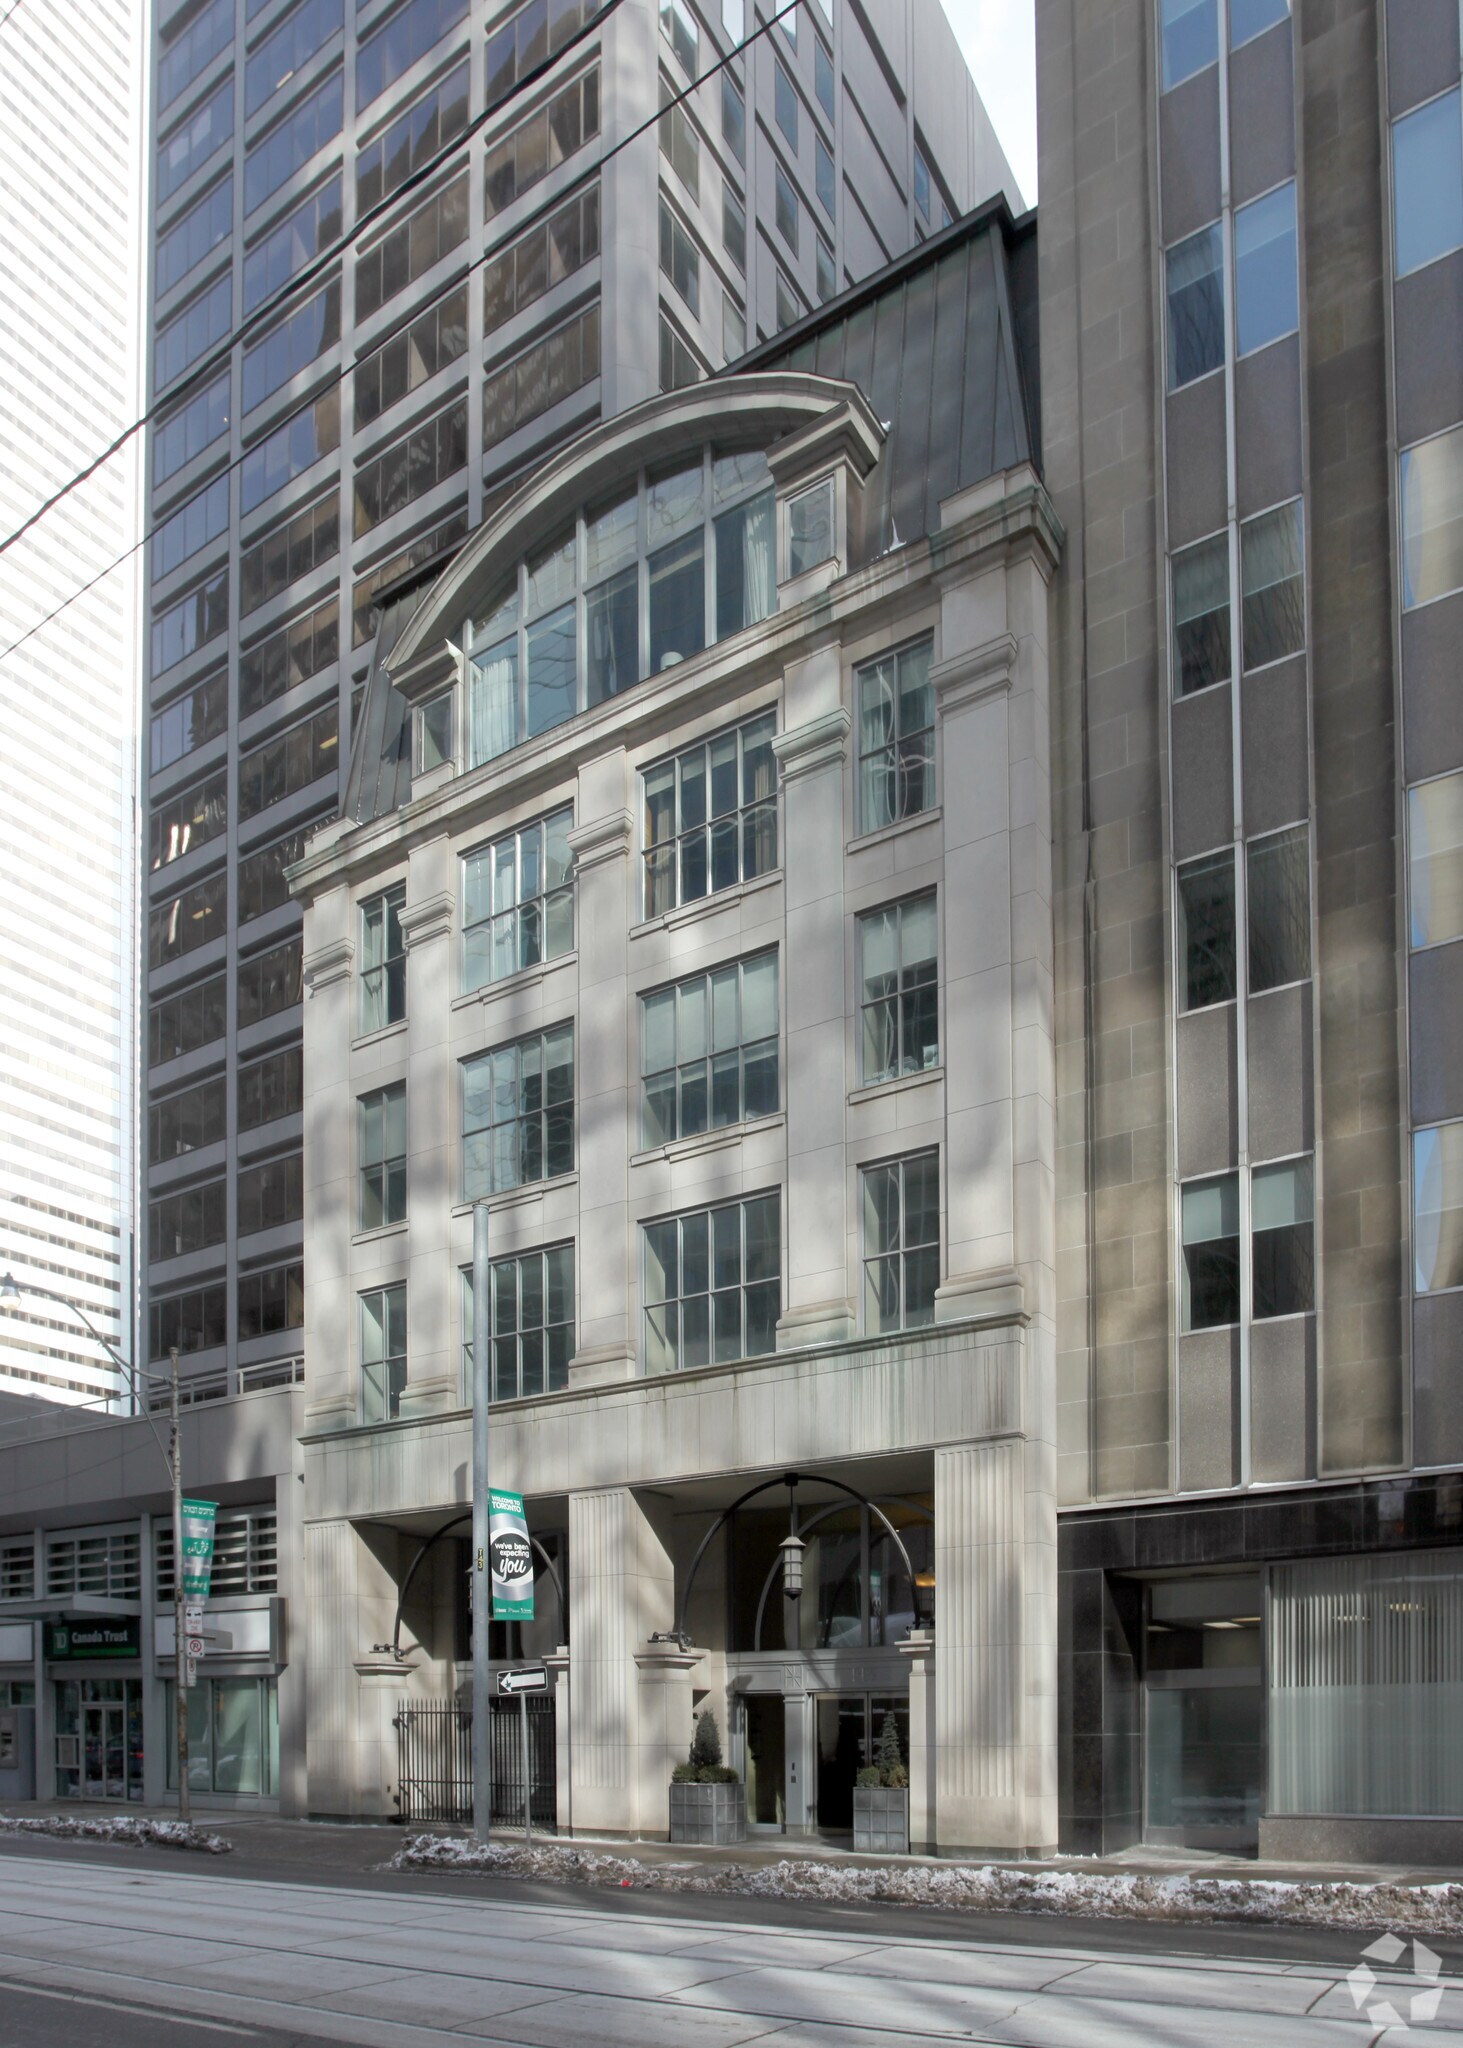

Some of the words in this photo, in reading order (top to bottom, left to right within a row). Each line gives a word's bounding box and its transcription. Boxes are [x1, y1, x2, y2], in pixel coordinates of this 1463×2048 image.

[491, 1495, 514, 1505] WELCOME
[492, 1501, 522, 1512] TORONTO
[494, 1542, 513, 1550] we've
[500, 1550, 530, 1558] expecting
[500, 1558, 526, 1580] you
[54, 1632, 67, 1649] TD
[72, 1630, 103, 1644] Canada
[103, 1629, 128, 1642] Trust
